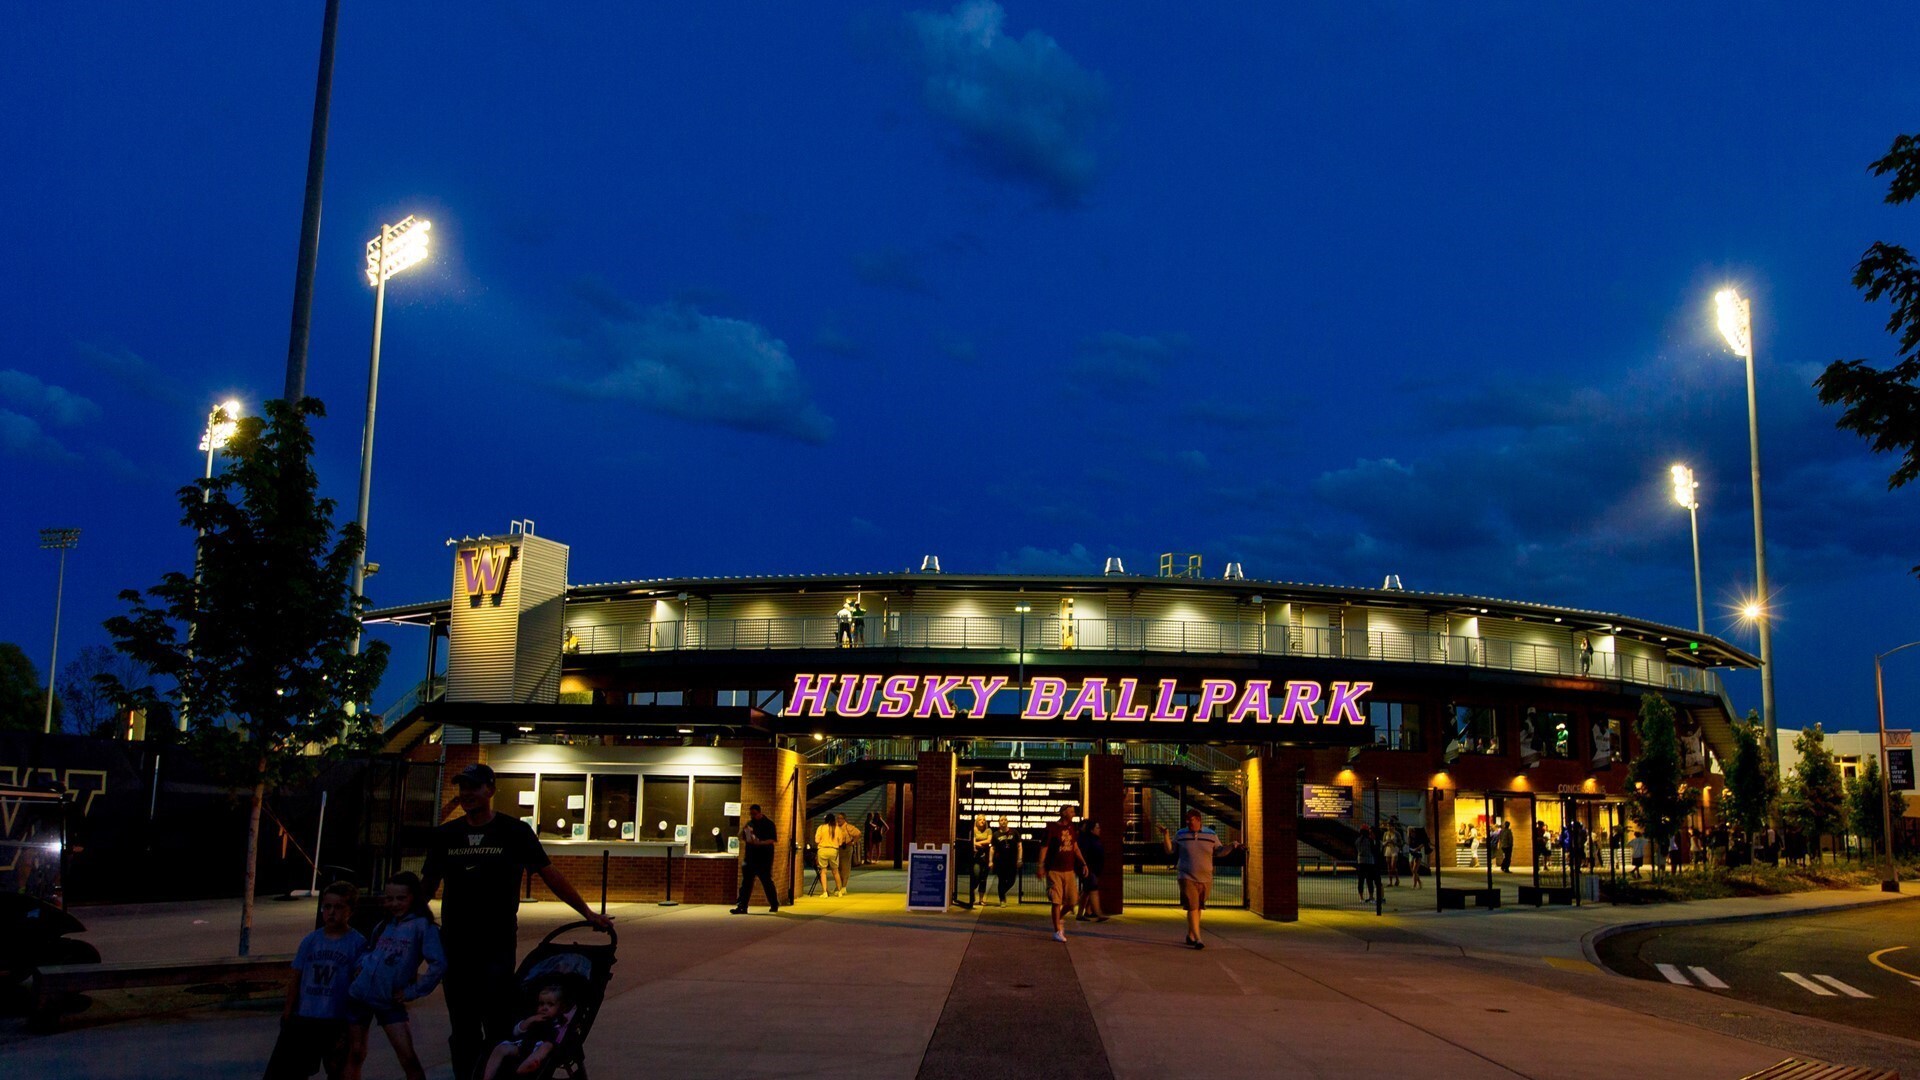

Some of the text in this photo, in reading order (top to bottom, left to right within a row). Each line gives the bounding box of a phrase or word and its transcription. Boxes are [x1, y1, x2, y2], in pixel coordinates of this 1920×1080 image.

[457, 544, 511, 596] W
[784, 673, 1374, 724] HUSKY BALLPARK
[468, 834, 485, 846] W
[447, 847, 503, 856] WASHINGTON
[312, 963, 338, 985] W
